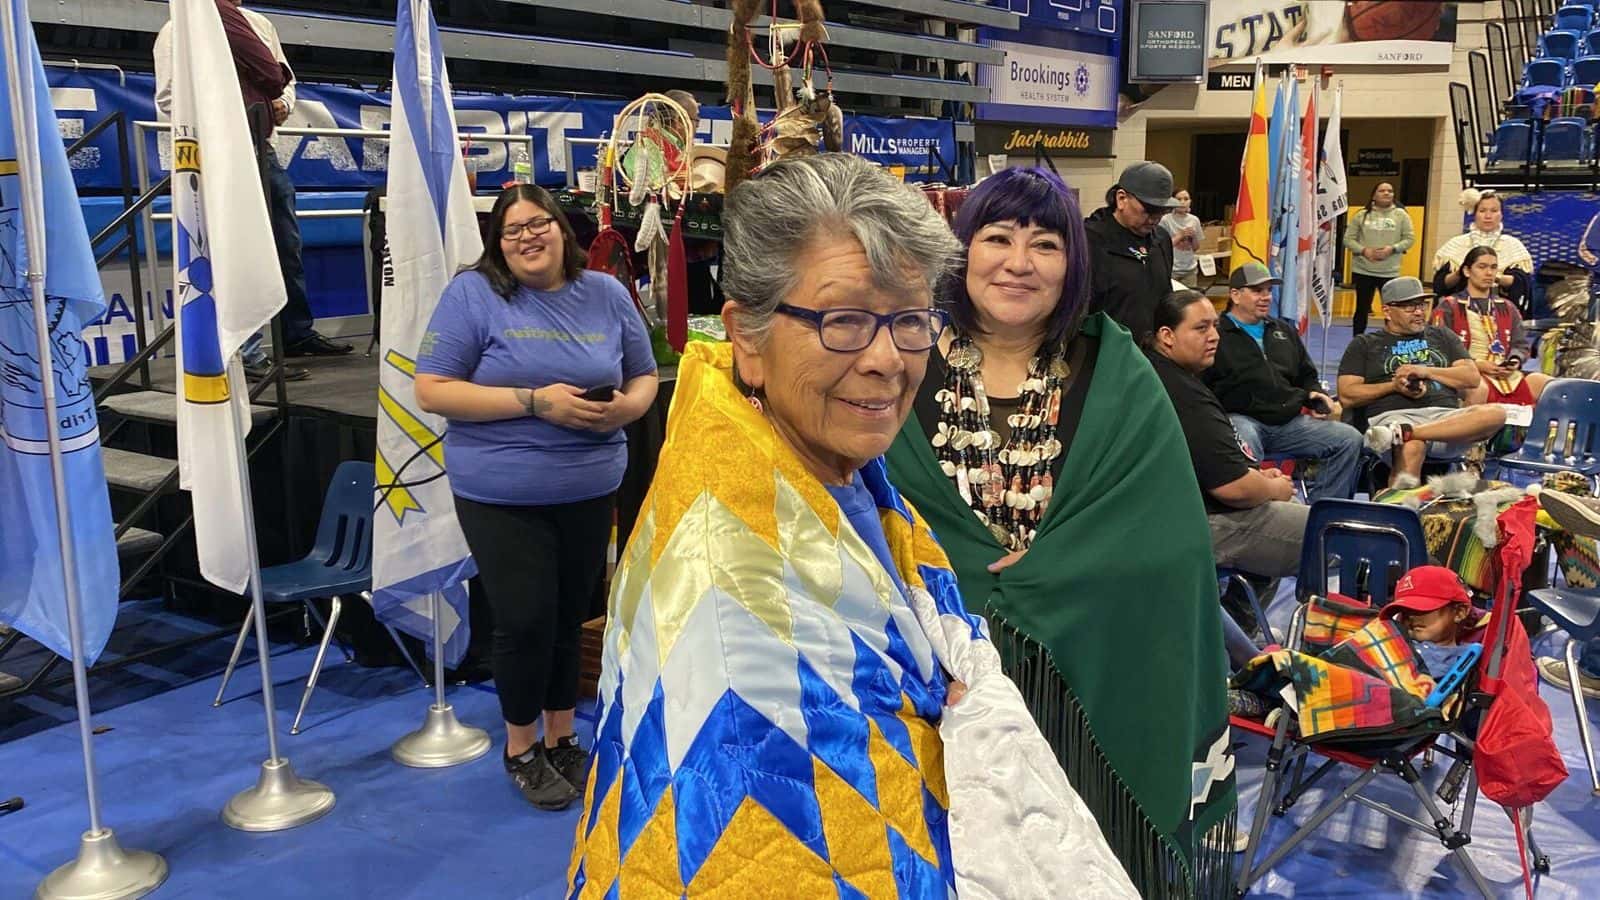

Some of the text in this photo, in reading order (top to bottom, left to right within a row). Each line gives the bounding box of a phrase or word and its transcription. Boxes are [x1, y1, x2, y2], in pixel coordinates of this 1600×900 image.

[1148, 30, 1194, 39] SANFORD
[1377, 53, 1423, 61] SANFORD
[1010, 61, 1070, 90] Brookings
[1221, 75, 1250, 87] MEN
[1020, 92, 1069, 103] HEALTH SYSTEM
[852, 133, 940, 154] MILLS PROPERTY
[1004, 129, 1089, 150] Jackrabbits
[898, 146, 941, 155] MANAGEMT
